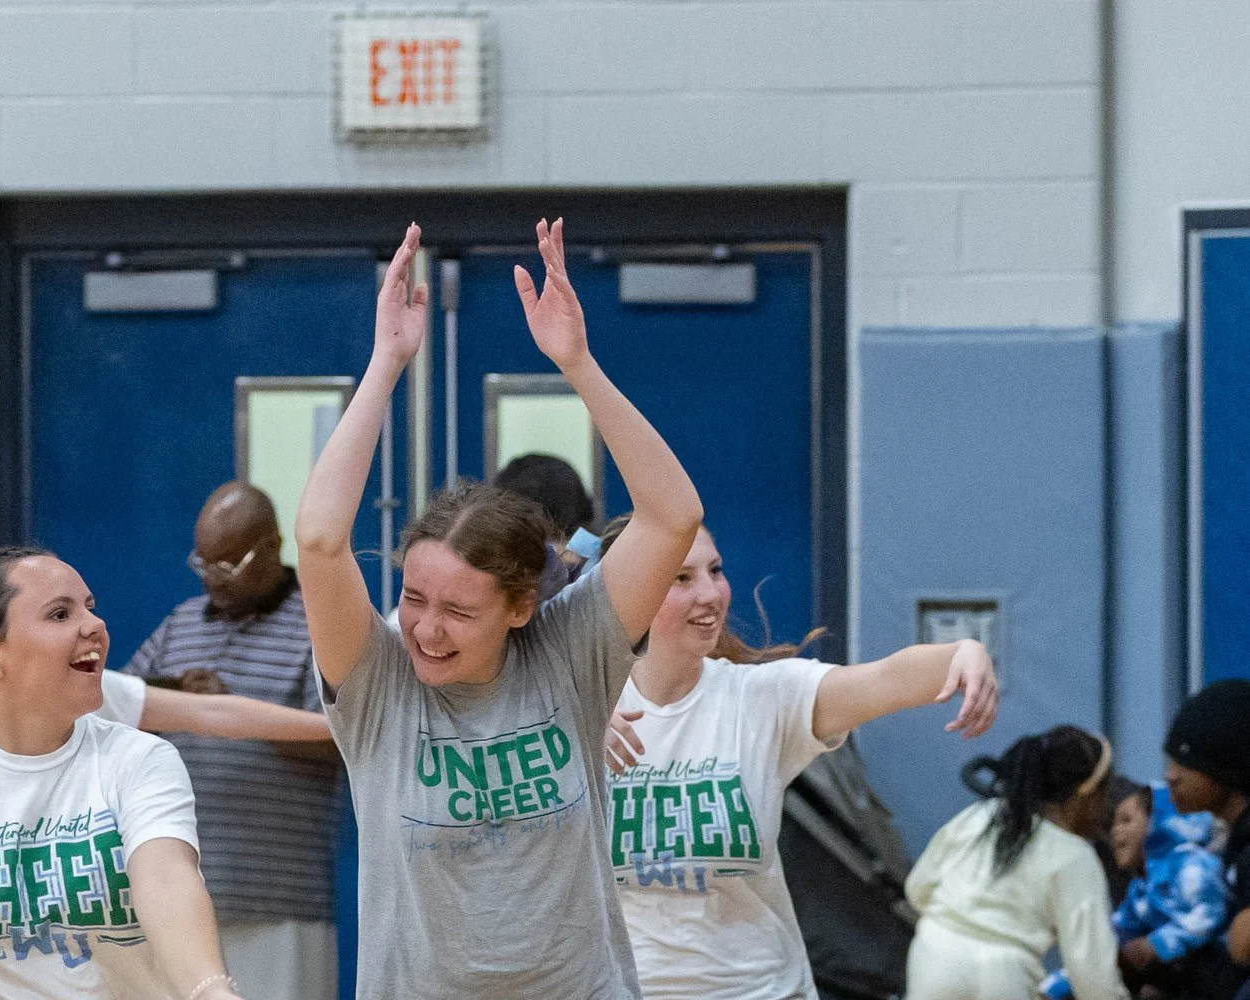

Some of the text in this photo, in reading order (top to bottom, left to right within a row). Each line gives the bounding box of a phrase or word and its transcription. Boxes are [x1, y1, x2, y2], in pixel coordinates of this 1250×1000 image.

[369, 39, 461, 106] EXIT
[417, 723, 571, 788] UNITED
[675, 757, 718, 778] United
[45, 806, 92, 838] United
[447, 777, 565, 821] CHEER
[611, 775, 761, 868] HEER
[6, 918, 93, 969] WU
